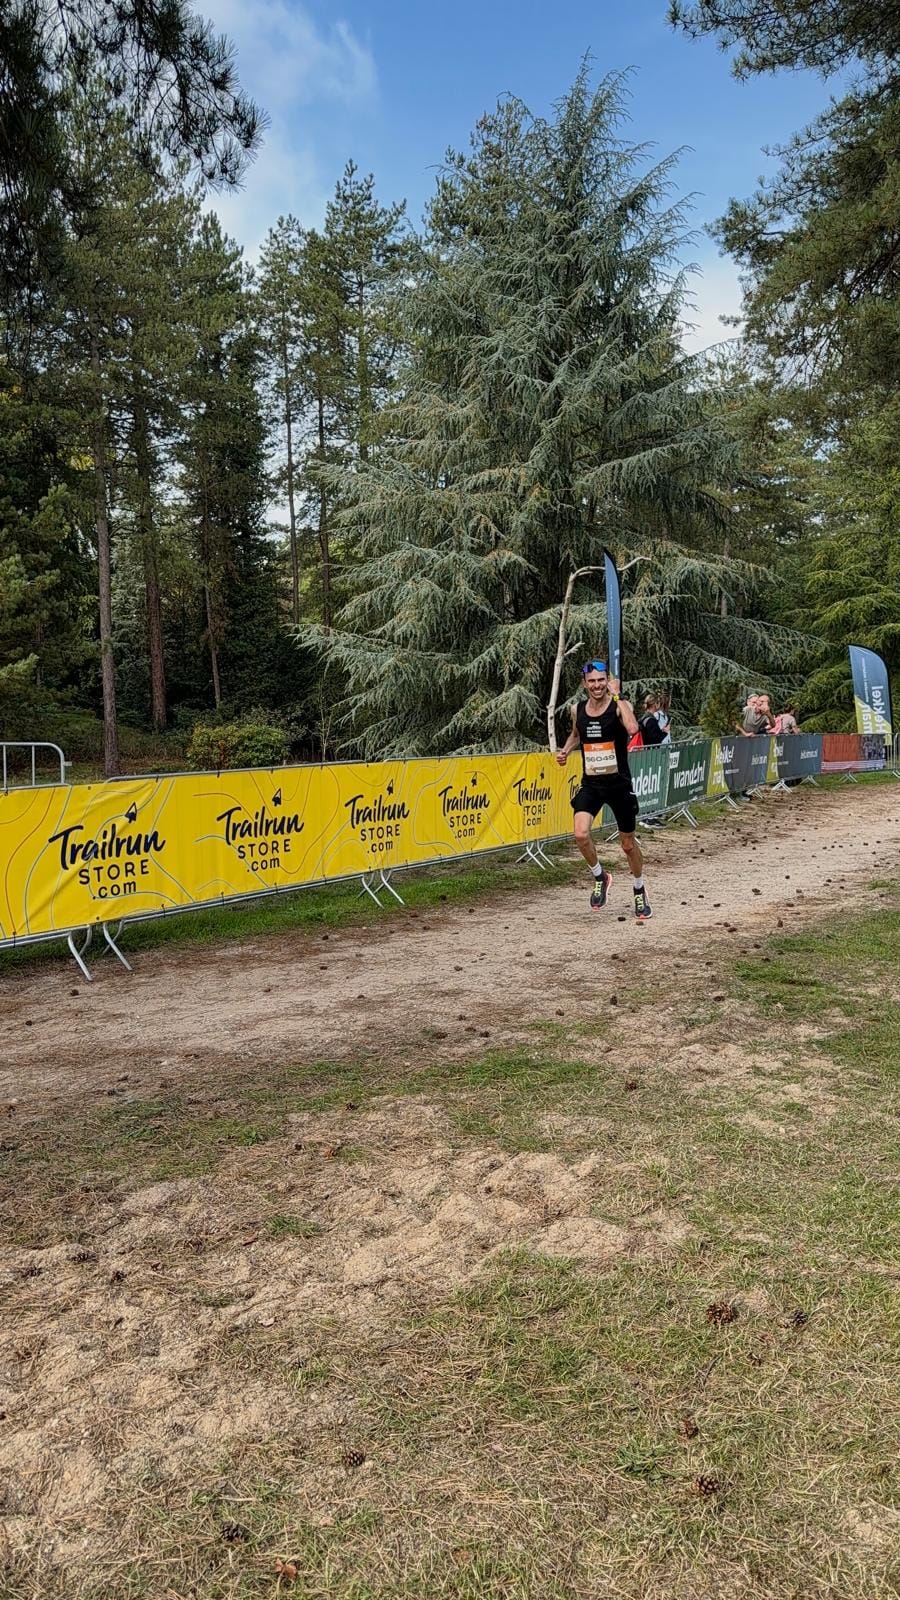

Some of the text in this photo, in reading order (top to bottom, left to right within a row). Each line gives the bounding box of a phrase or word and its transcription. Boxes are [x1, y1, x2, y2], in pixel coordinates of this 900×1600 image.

[438, 786, 490, 816] Trailrun
[513, 778, 552, 806] Trailrun
[344, 794, 410, 829] Trailrun
[449, 813, 482, 828] STORE
[523, 804, 546, 817] TORE
[216, 806, 304, 845] Trailrun
[360, 823, 401, 841] STORE
[48, 823, 166, 870] Trailrun
[237, 839, 291, 859] STORE
[367, 840, 393, 854] .com
[78, 859, 150, 885] STORE
[247, 857, 280, 873] .com
[92, 880, 137, 900] .com
